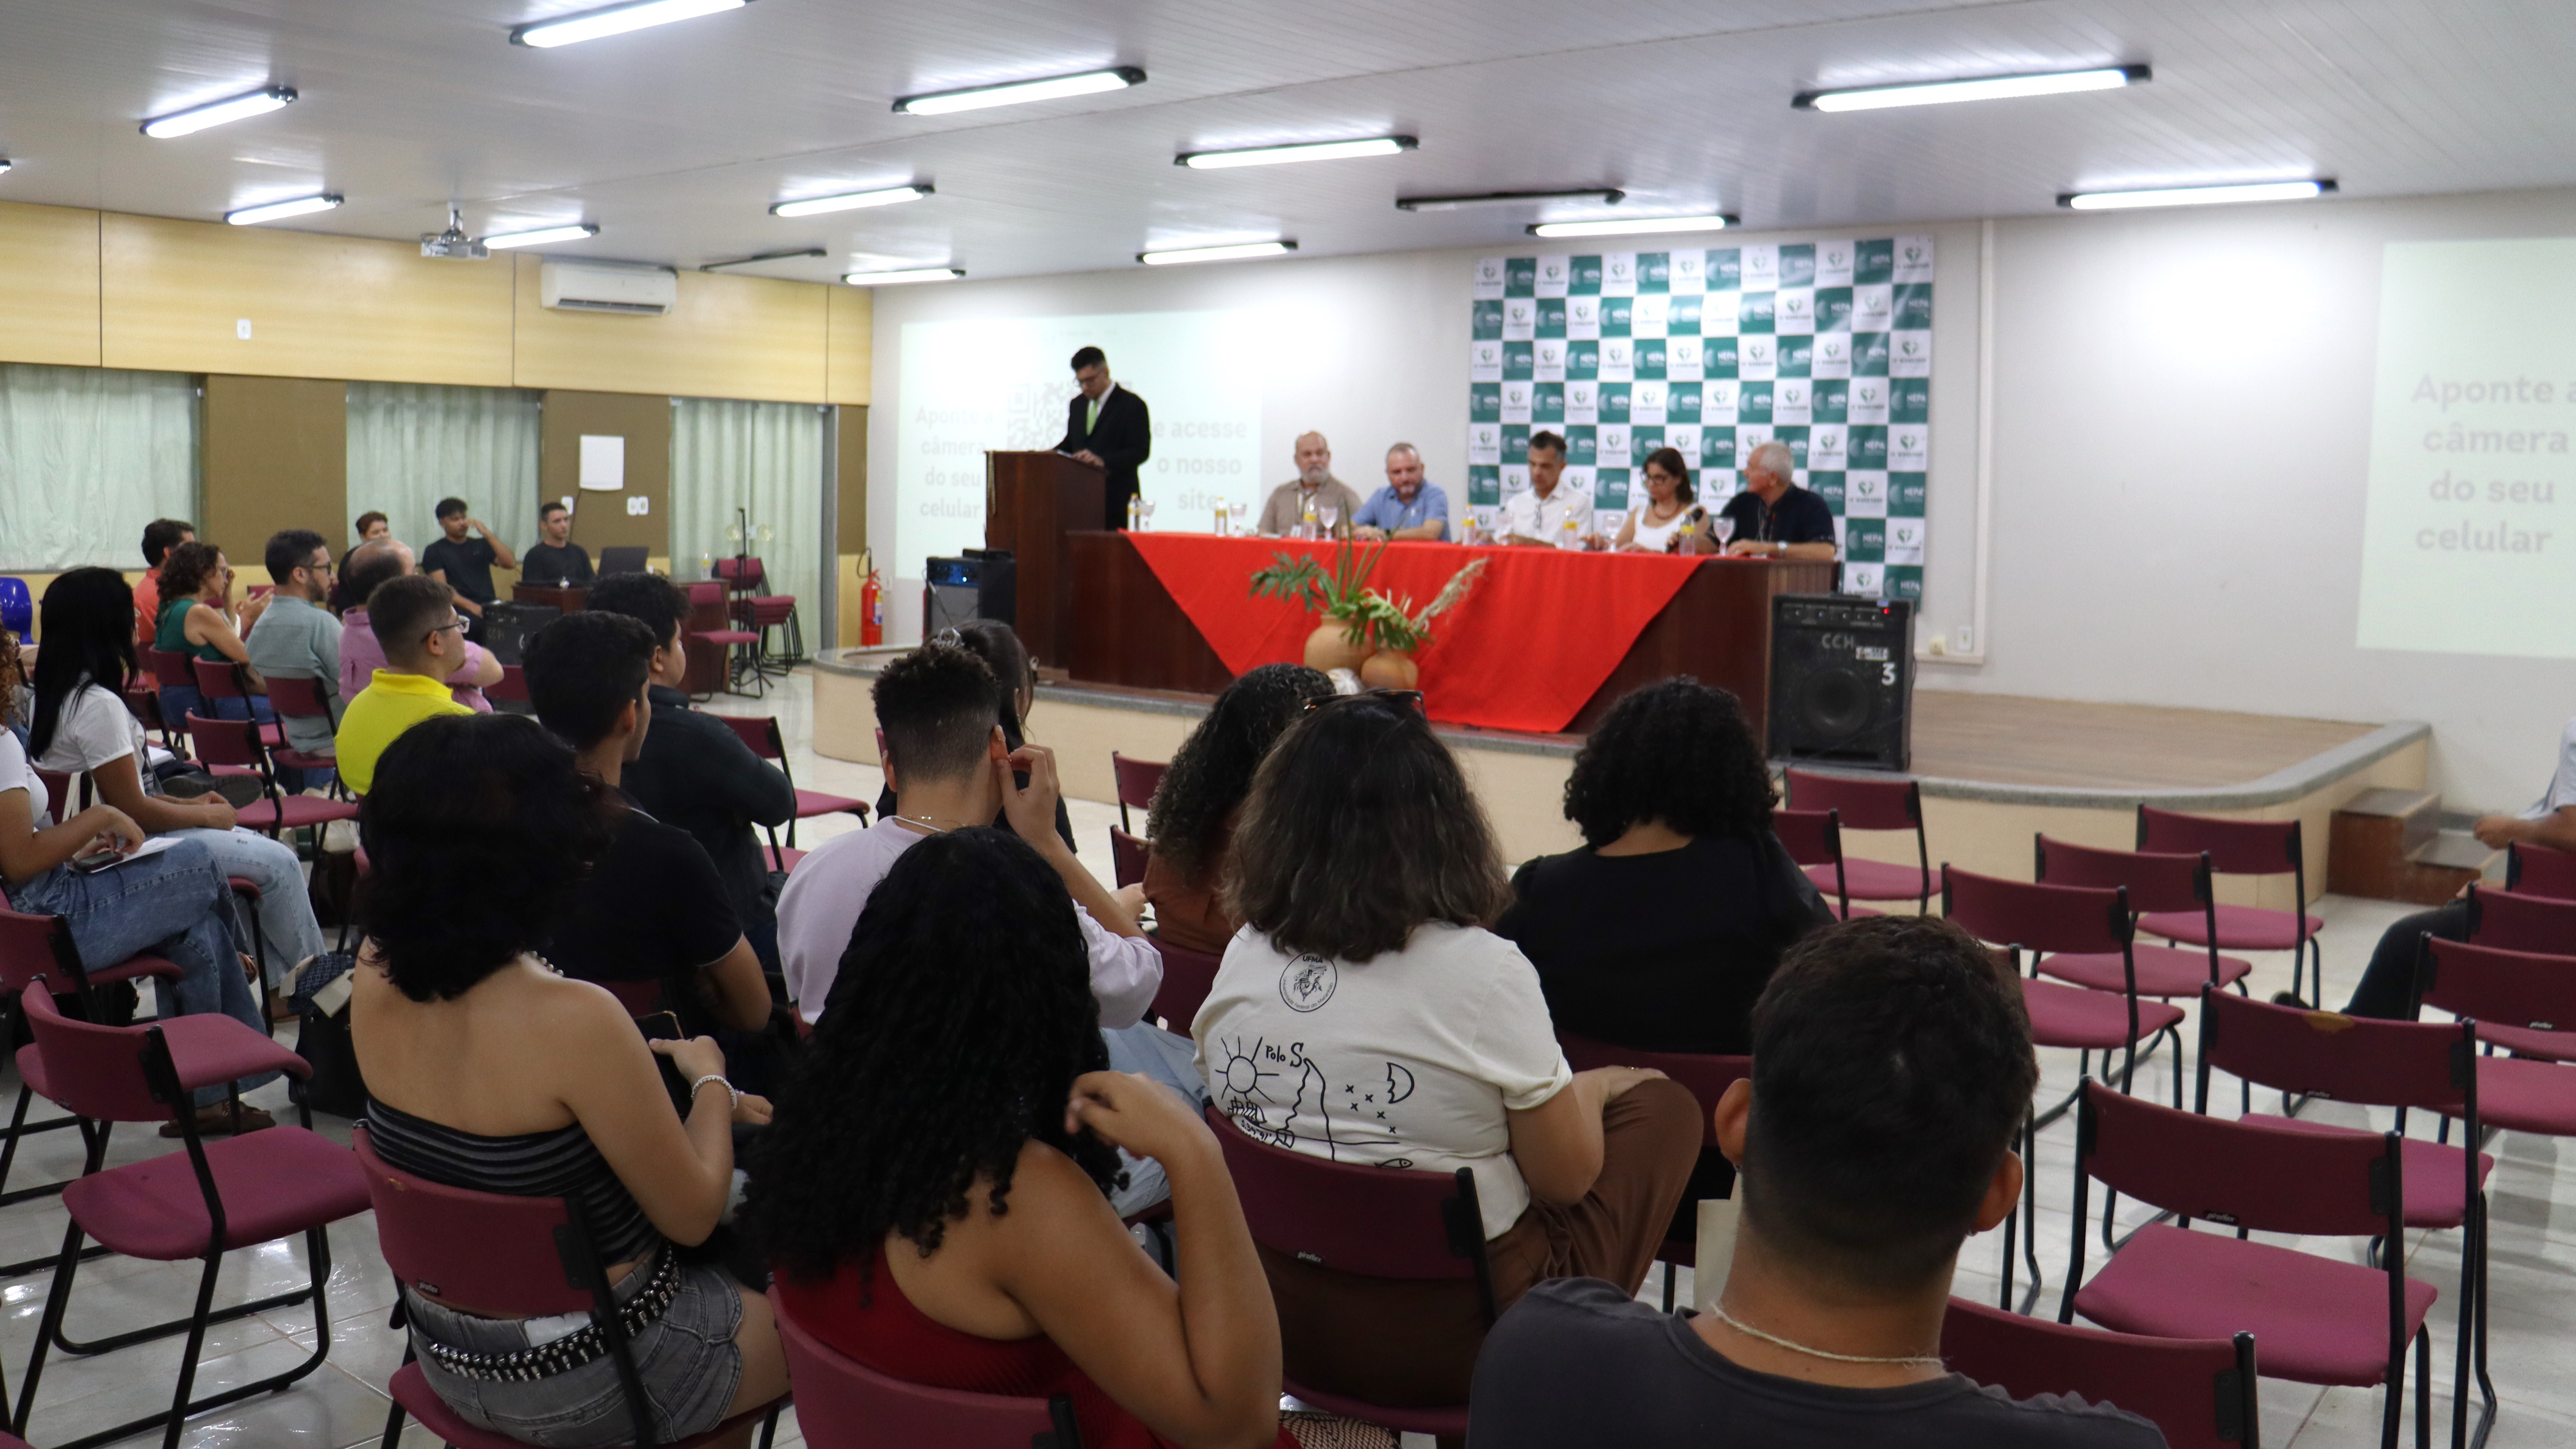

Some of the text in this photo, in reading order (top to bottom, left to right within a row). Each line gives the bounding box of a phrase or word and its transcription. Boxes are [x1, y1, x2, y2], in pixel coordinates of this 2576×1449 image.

[2411, 372, 2555, 413] Aponte
[915, 405, 981, 431] Aponte
[1153, 421, 1247, 439] e acesse
[2423, 420, 2570, 454] câmera
[921, 434, 986, 456] câmera
[924, 465, 982, 487] do seu
[1157, 457, 1242, 475] o nosso
[2428, 469, 2555, 504] do seu
[920, 496, 982, 519] celular
[1177, 487, 1218, 511] site
[2415, 519, 2553, 553] celular
[1821, 632, 1855, 650] CCH
[1881, 662, 1896, 686] 3
[1302, 955, 1323, 963] UFMA
[1282, 976, 1294, 1005] Universidade
[1317, 982, 1334, 1005] Maranhão
[1265, 1045, 1286, 1062] Polo
[1297, 1251, 1322, 1263] giroflex
